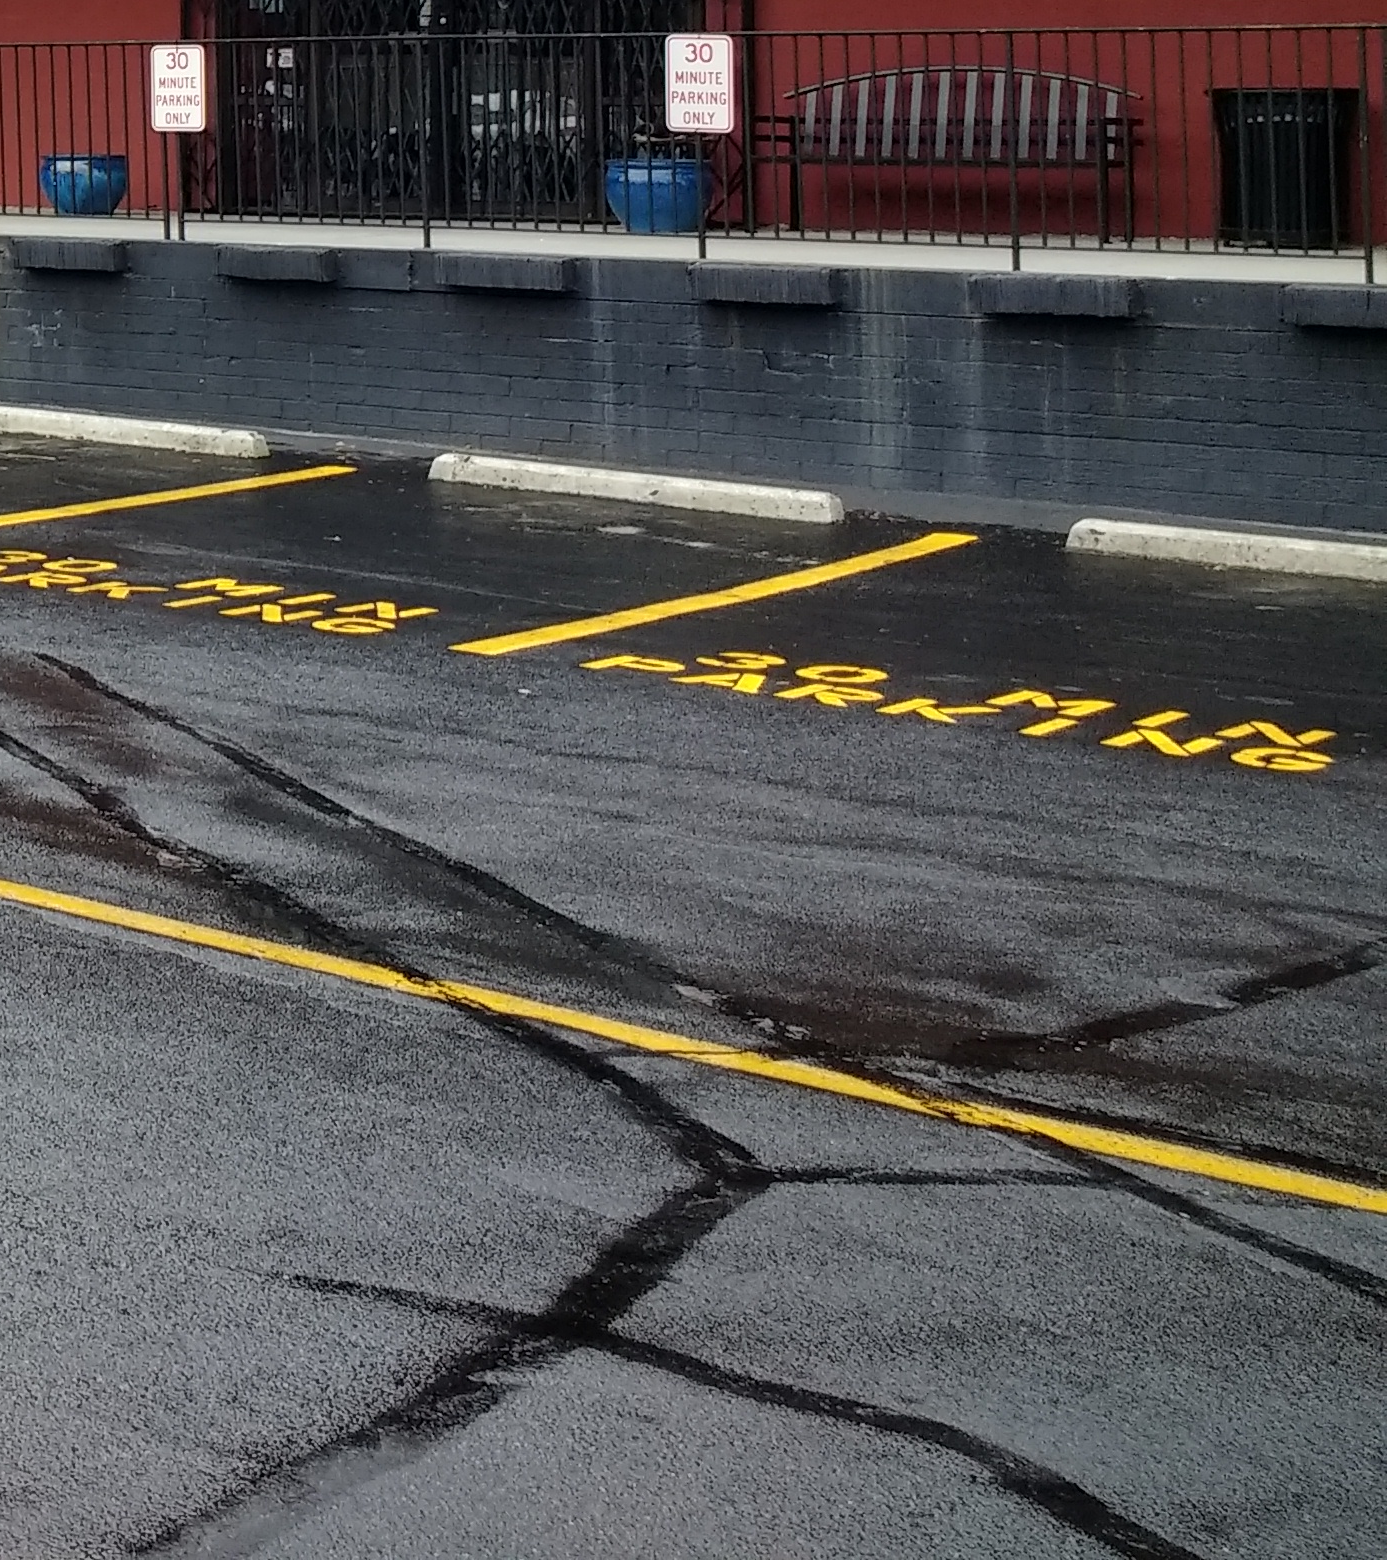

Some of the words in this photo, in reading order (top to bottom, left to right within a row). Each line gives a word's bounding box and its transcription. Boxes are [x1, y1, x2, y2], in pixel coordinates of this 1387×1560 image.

[684, 43, 713, 63] 30
[166, 52, 189, 70] 30
[158, 77, 197, 89] MINUTE
[675, 71, 723, 85] MINUTE
[156, 94, 200, 107] PARKING
[671, 91, 727, 105] PARKING
[165, 112, 191, 124] ONLY
[683, 111, 715, 125] ONLY
[175, 577, 439, 620] MIN
[695, 651, 889, 685] 30
[985, 689, 1339, 748] MIN
[578, 655, 1336, 773] PARKING
